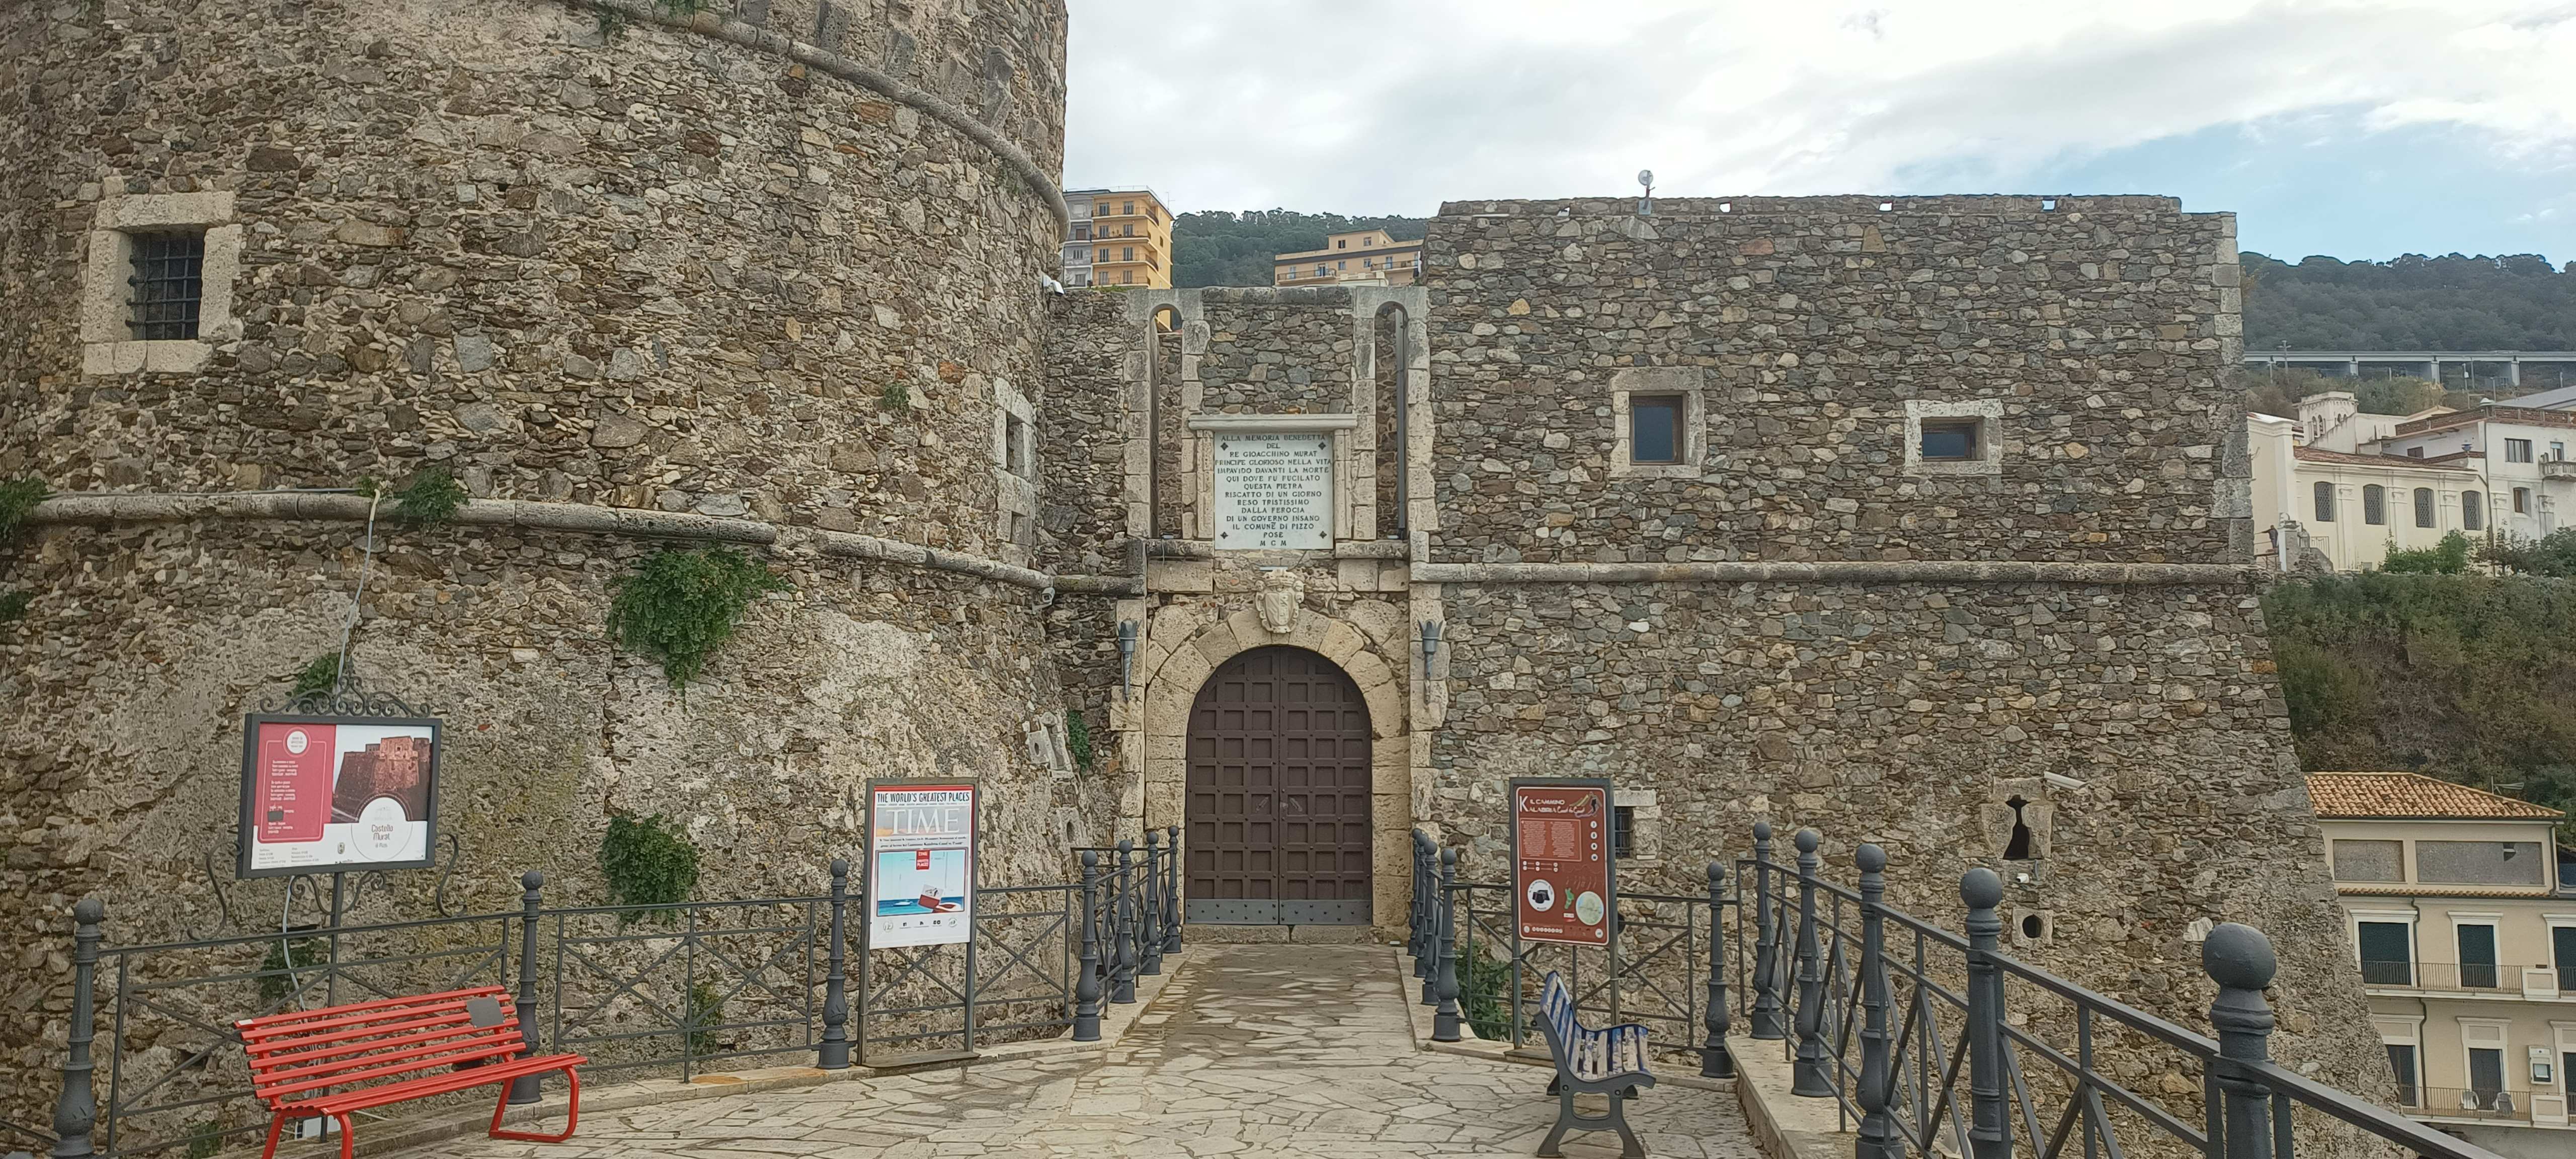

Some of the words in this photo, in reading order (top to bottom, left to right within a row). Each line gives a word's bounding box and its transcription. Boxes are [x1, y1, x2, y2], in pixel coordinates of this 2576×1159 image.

[877, 793, 888, 802] THE
[891, 793, 917, 802] WORLD'S
[919, 793, 946, 802] GREATEST
[949, 792, 970, 801] PLACES
[886, 808, 959, 834] TIME
